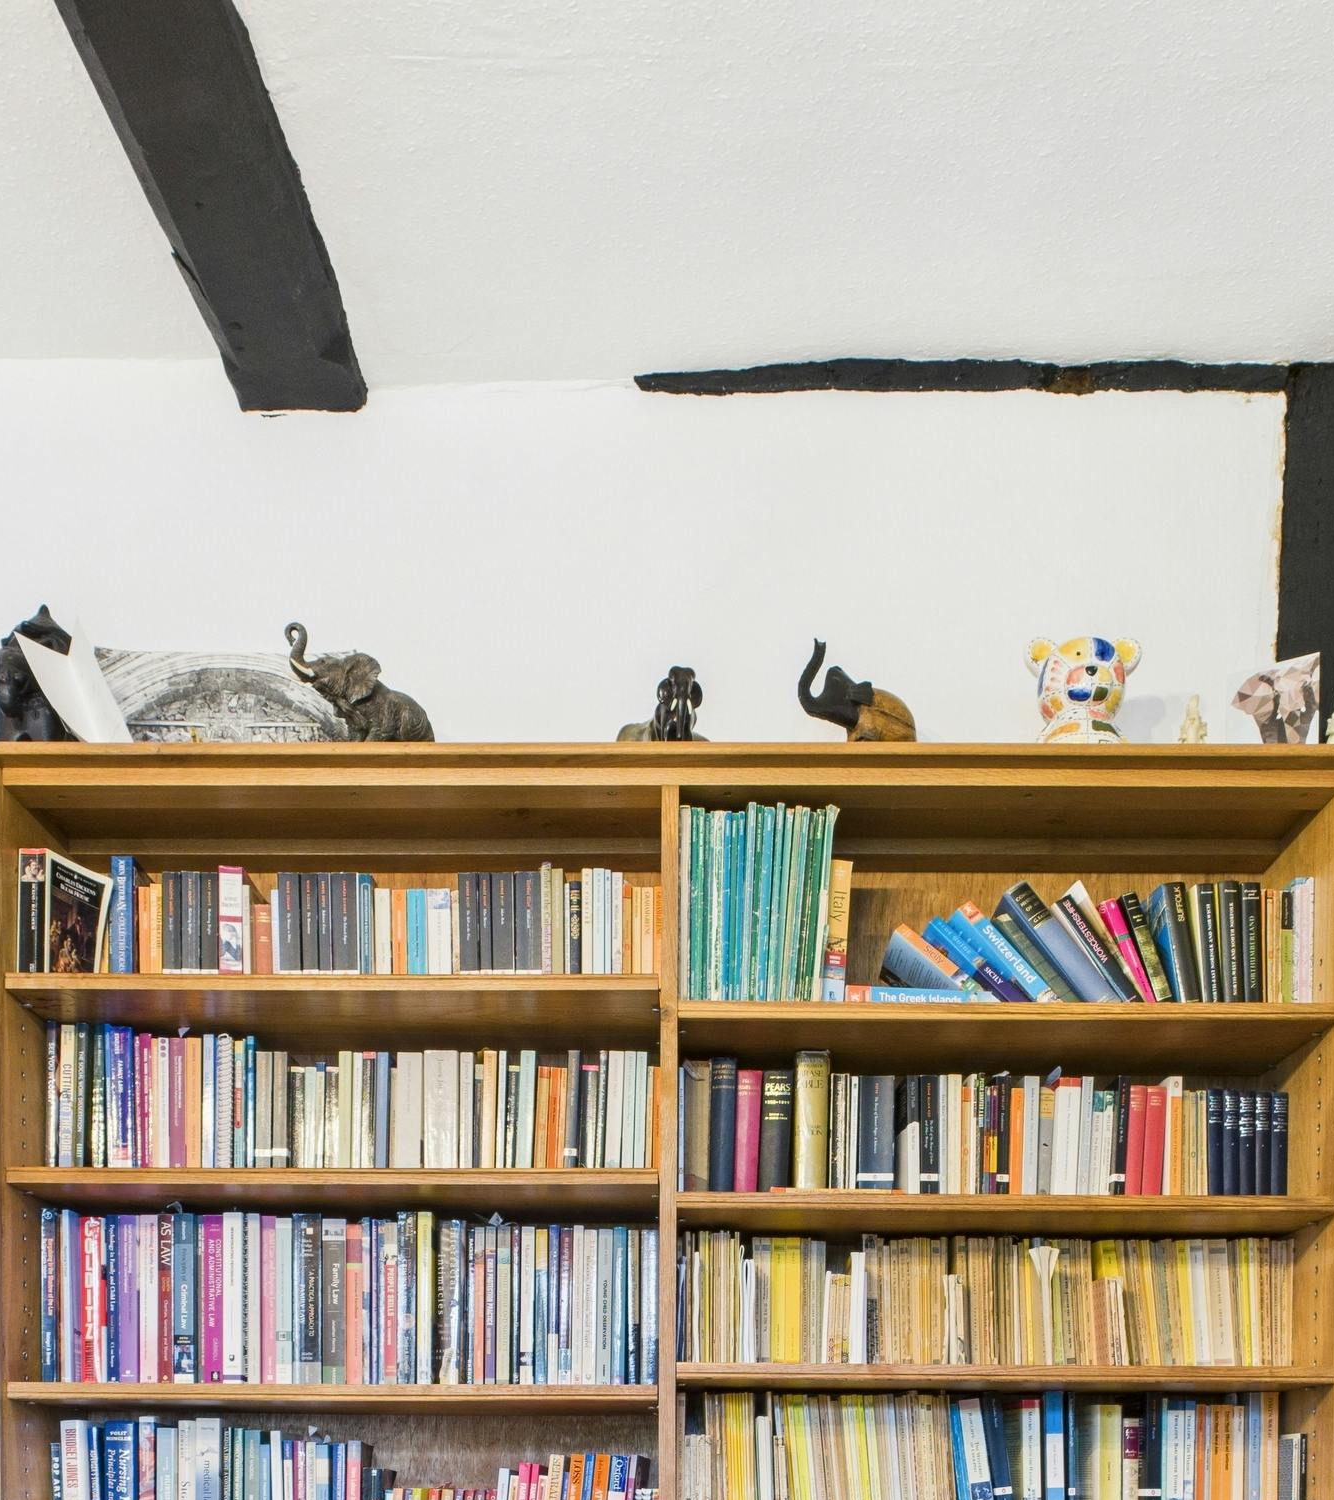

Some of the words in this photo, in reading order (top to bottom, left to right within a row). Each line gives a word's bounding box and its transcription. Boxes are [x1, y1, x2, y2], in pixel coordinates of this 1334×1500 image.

[117, 859, 125, 876] JOHN
[829, 889, 848, 922] Italy
[1062, 900, 1109, 964] WORCESTERSHIRE
[983, 925, 1037, 984] Switzerland
[983, 967, 1002, 986] SICILY
[160, 1222, 171, 1236] AS
[160, 1240, 171, 1265] LAW
[214, 1239, 222, 1296] CONSTITUTIONAL
[386, 1267, 395, 1292] PEOPLE
[208, 1255, 216, 1312] ADMINISTRATIVE
[386, 1293, 394, 1316] SKILLS
[208, 1313, 216, 1328] LAW
[65, 1428, 78, 1459] BRIDGET
[66, 1462, 79, 1488] JONES
[106, 1449, 116, 1489] Principles
[117, 1449, 130, 1494] Nursing
[201, 1460, 212, 1493] medical
[570, 1459, 583, 1485] LOSS
